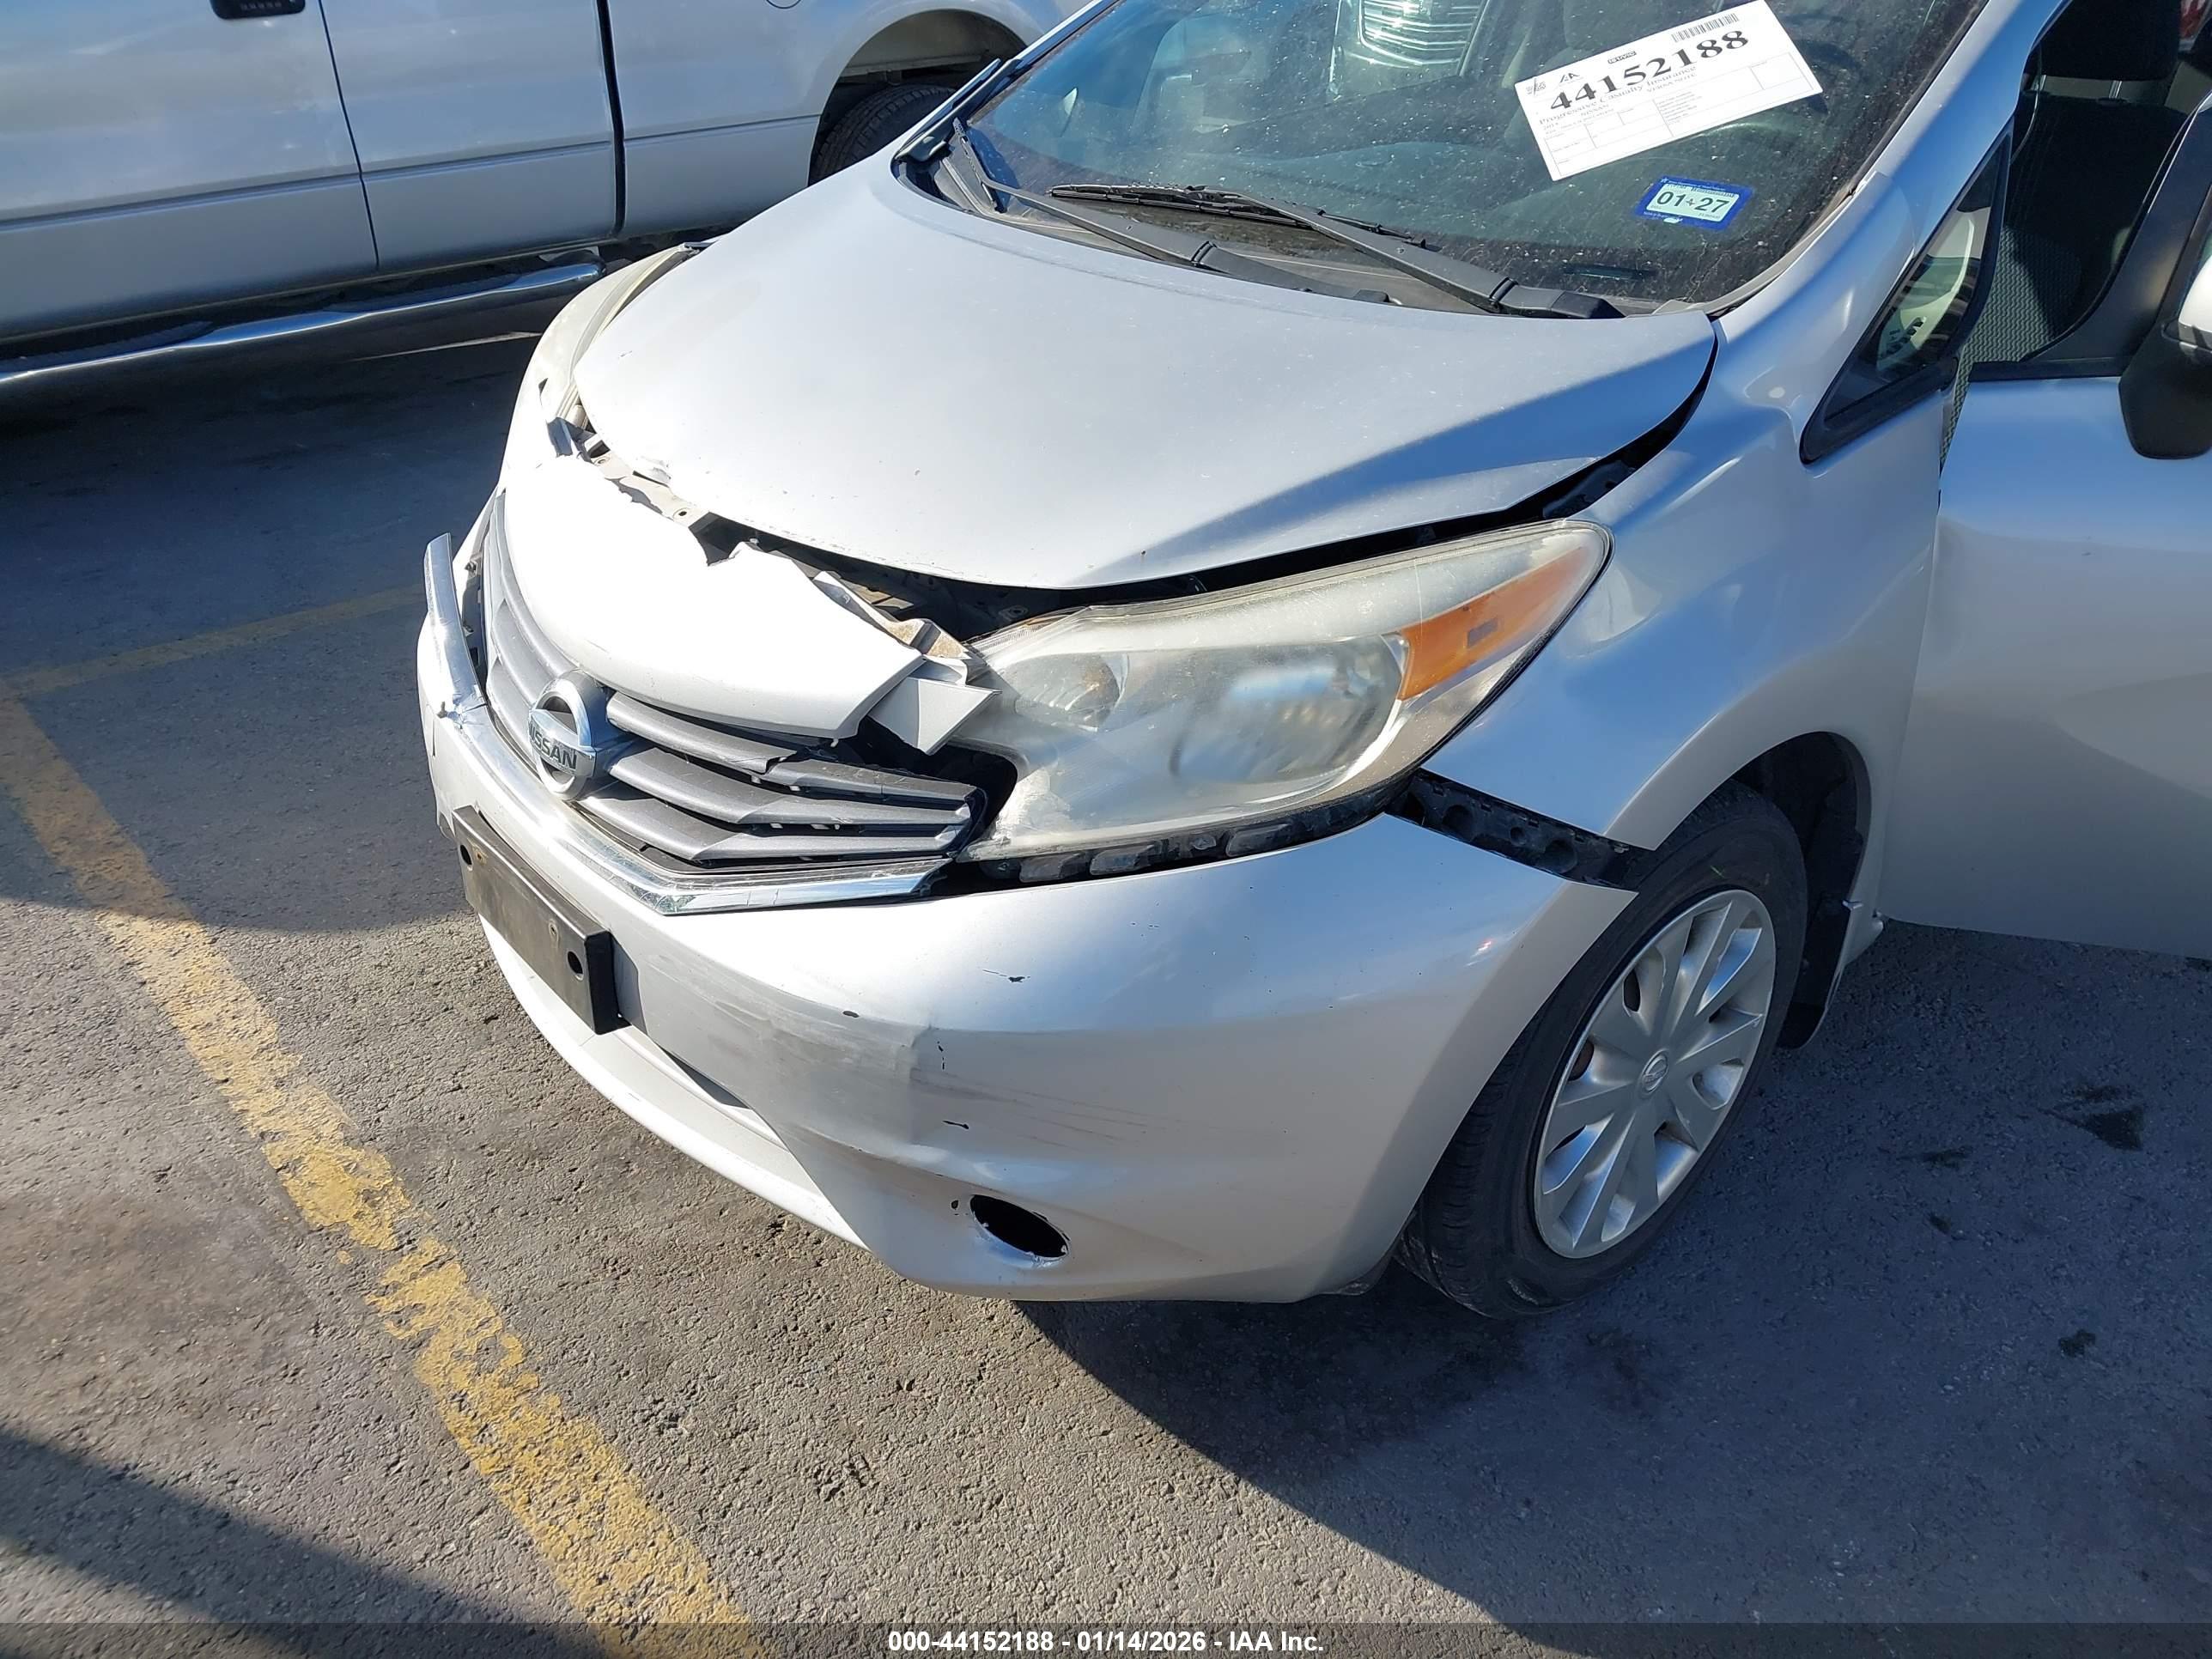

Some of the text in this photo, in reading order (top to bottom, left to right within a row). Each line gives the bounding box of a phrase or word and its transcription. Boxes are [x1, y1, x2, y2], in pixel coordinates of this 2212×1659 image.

[1550, 29, 1749, 110] 44152188
[1656, 191, 1730, 213] 01 27
[528, 721, 578, 770] NISSAN
